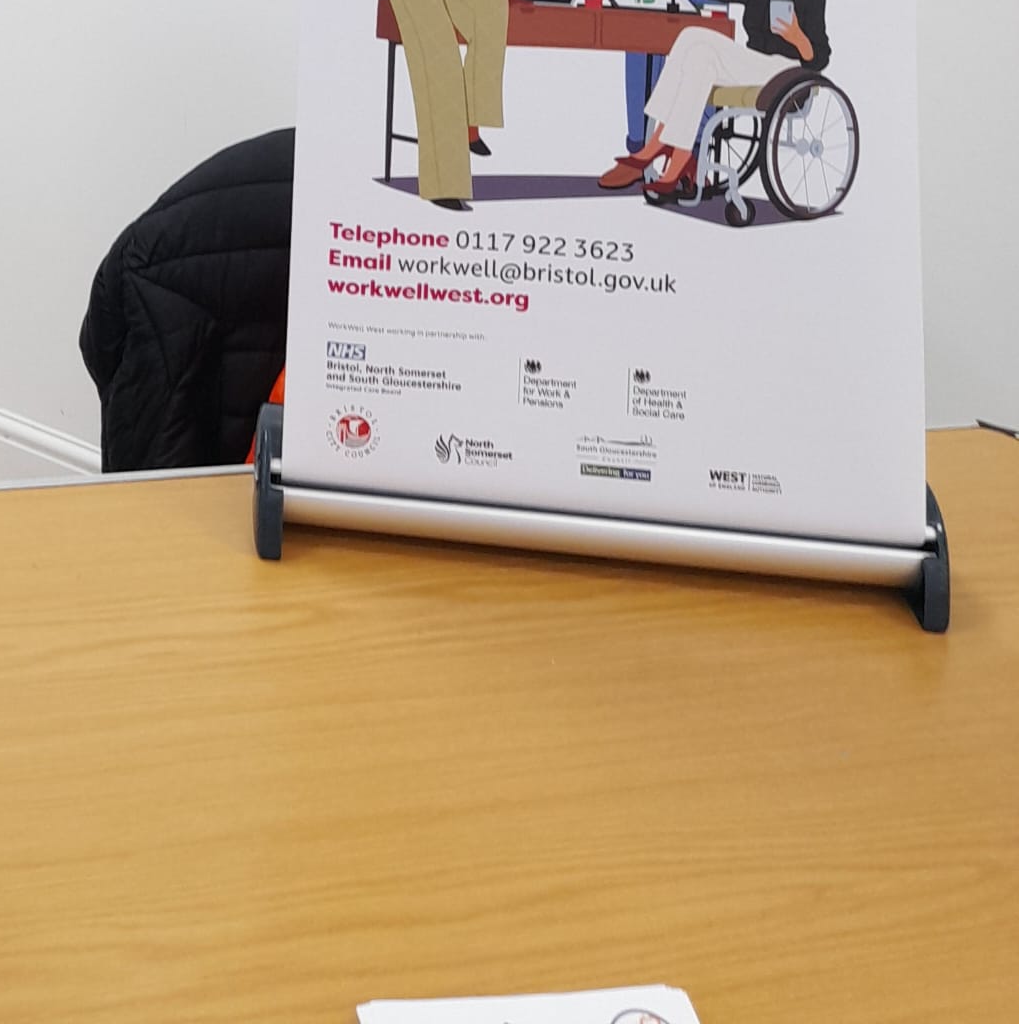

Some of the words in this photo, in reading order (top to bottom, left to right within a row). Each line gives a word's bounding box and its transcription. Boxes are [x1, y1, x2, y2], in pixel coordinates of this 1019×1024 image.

[330, 222, 449, 248] Telephone
[456, 230, 515, 252] 0117
[522, 235, 566, 256] 922
[574, 238, 633, 262] 3623
[329, 250, 392, 271] Email
[398, 256, 676, 294] workwell@bristol.gov.uk
[328, 279, 529, 312] workwellwest.org
[367, 326, 384, 334] West
[387, 328, 415, 337] working
[426, 331, 467, 341] partnership
[328, 341, 366, 360] NHS
[327, 361, 361, 373] Bristol,
[366, 365, 395, 375] North
[399, 367, 446, 378] Somerset
[327, 373, 345, 382] and
[349, 374, 378, 384] South
[382, 376, 461, 391] Gloucestershire
[523, 376, 576, 389] Department
[523, 387, 534, 396] for
[538, 388, 560, 398] Work
[633, 385, 686, 399] Department
[523, 398, 563, 409] Pensions
[633, 397, 641, 405] of
[644, 398, 673, 408] Health
[632, 408, 660, 417] Social
[663, 410, 685, 420] Care
[465, 438, 493, 448] North
[465, 448, 512, 460] Somerset
[709, 469, 747, 483] WEST
